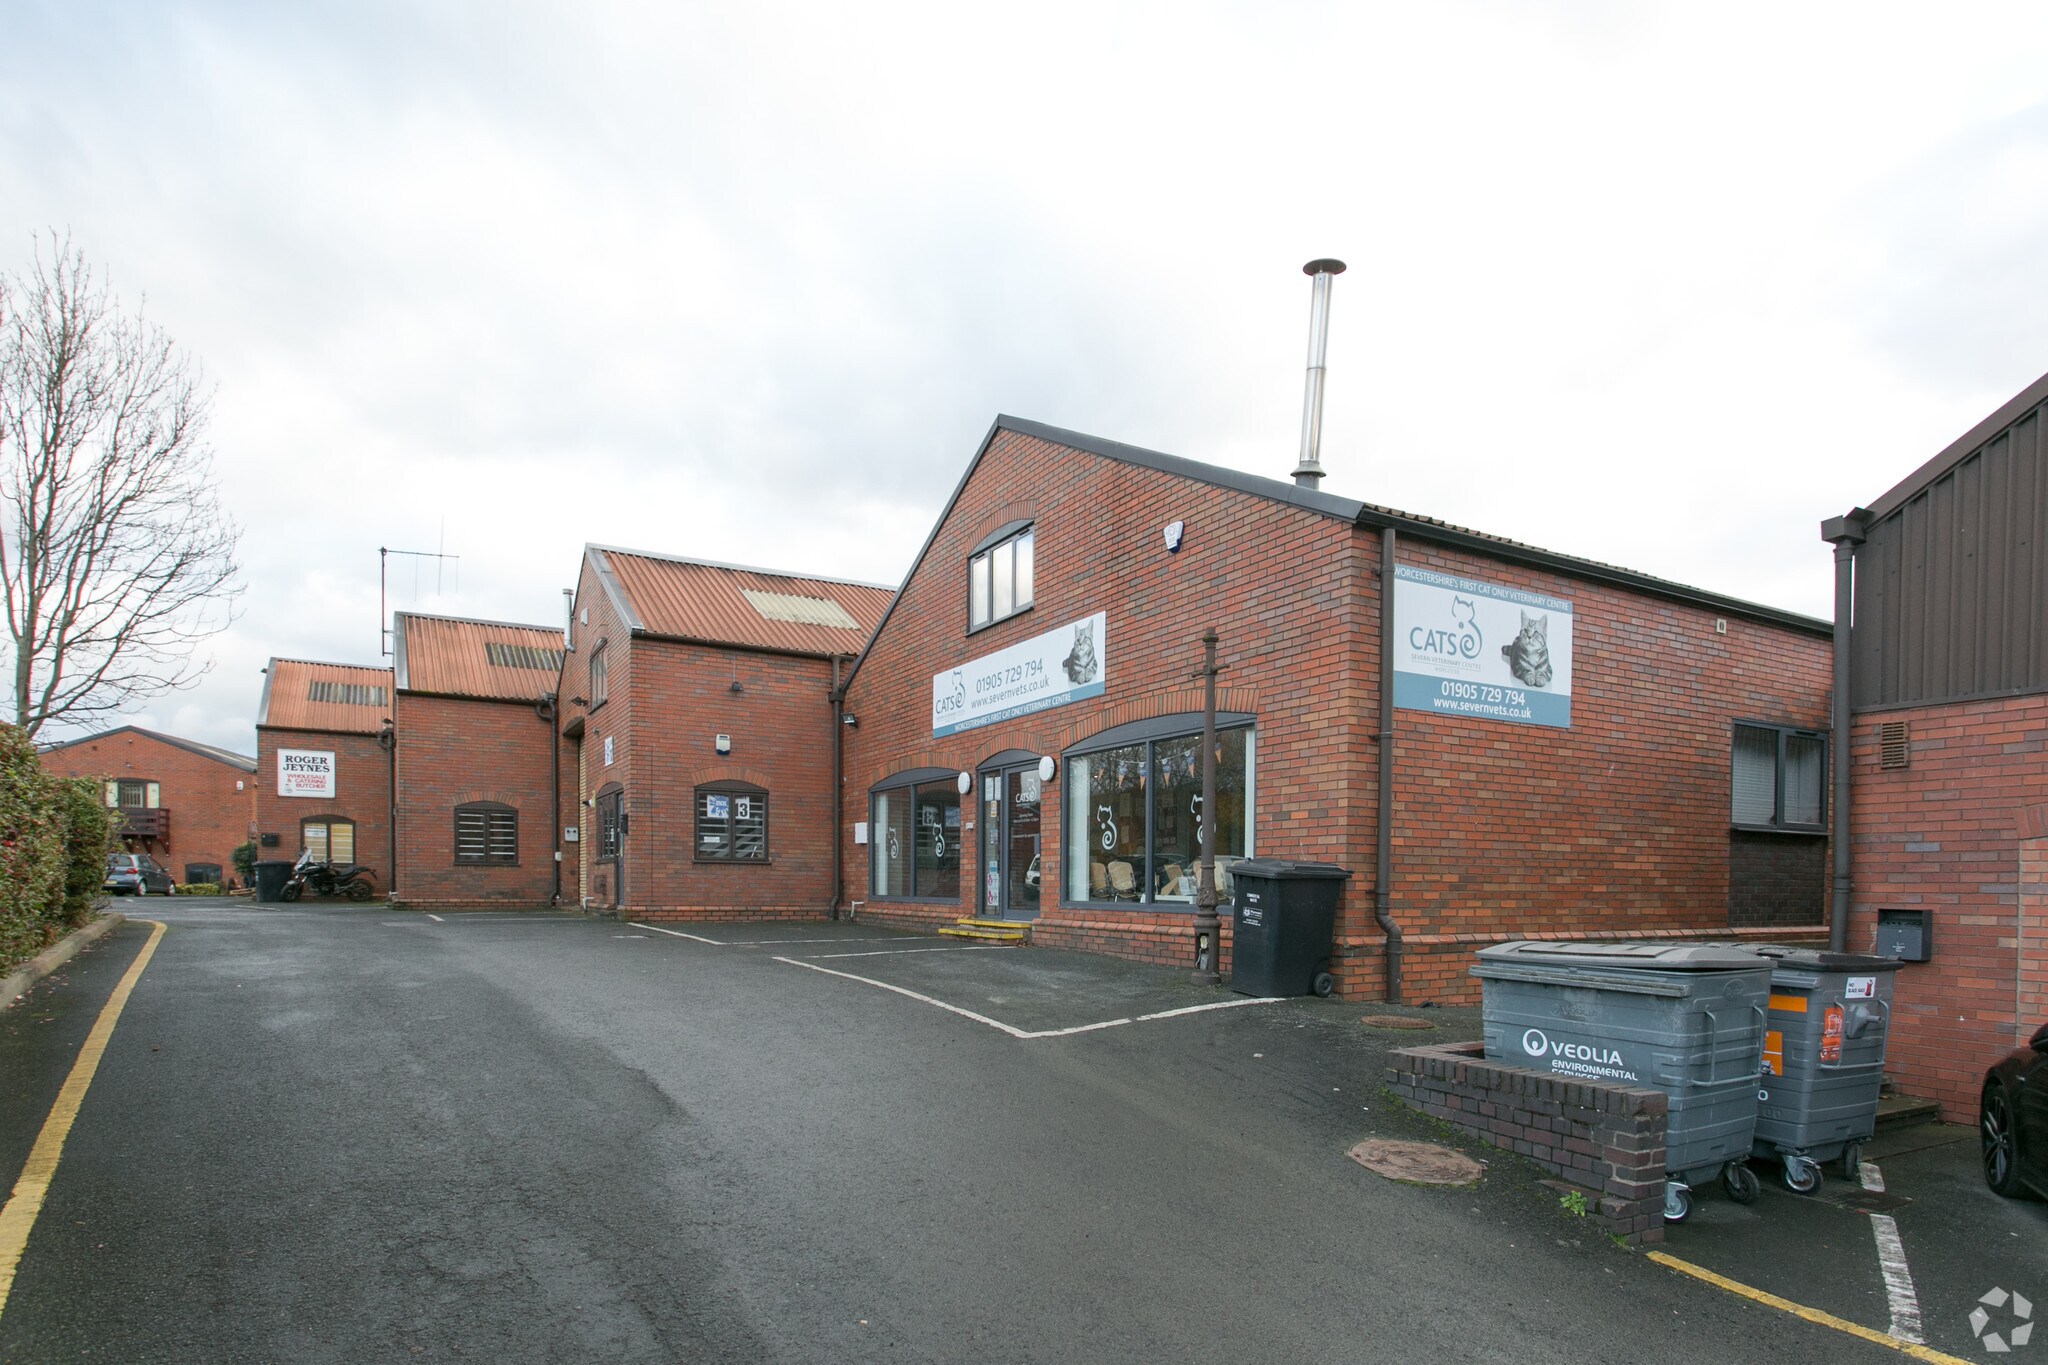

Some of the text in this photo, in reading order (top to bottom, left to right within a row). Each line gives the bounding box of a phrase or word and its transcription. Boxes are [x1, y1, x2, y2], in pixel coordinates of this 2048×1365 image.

[1394, 566, 1569, 610] WORCESTERSHIRE'S FIRST CAT ONLY VETERINARY CENTRE
[1410, 626, 1457, 656] CATS
[1411, 653, 1431, 661] SEVERN
[1431, 656, 1461, 667] VETERINARY
[976, 658, 1043, 693] 01905 729 794
[971, 674, 1050, 709] www.severnvets.co.uk
[1441, 681, 1526, 706] 01905 729 794
[936, 695, 955, 714] CATS
[955, 715, 991, 731] WORCESTERSHIRE'S
[991, 712, 1001, 722] FIRST
[1002, 709, 1011, 719] CAT
[1011, 706, 1023, 717] ONLY
[1023, 699, 1052, 713] VETERINARY
[1052, 692, 1071, 705] CENTRE
[1434, 697, 1532, 719] www.severnvets.co.uk
[283, 763, 330, 773] JEYNES
[285, 755, 328, 764] ROGER
[1015, 792, 1030, 803] CATS
[1550, 1040, 1624, 1066] VEOLIA
[1552, 1059, 1639, 1082] ENVIRONMENTAL
